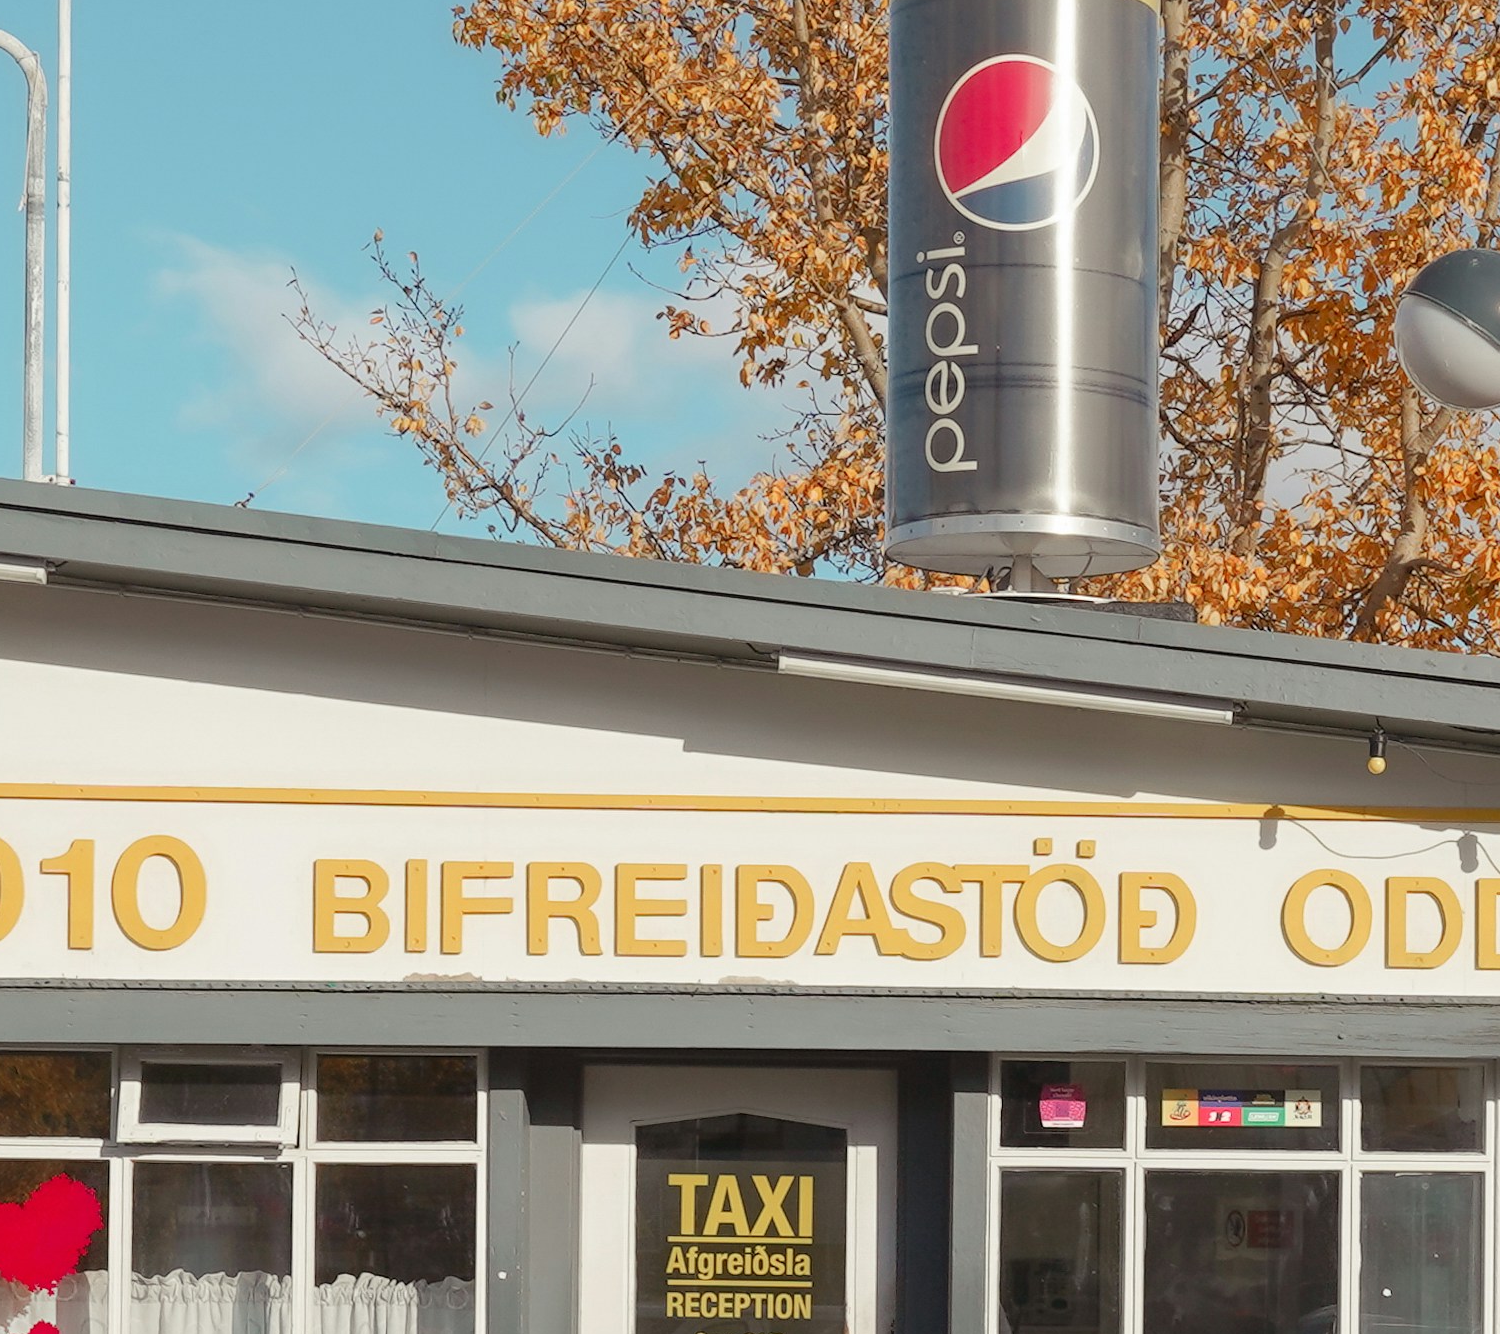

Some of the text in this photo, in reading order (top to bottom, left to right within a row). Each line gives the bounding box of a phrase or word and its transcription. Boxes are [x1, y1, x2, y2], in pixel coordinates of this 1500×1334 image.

[917, 245, 979, 473] pepsi
[668, 1174, 814, 1237] TAXI
[666, 1245, 812, 1280] Afgreiðsla
[666, 1292, 812, 1320] RECEPTION
